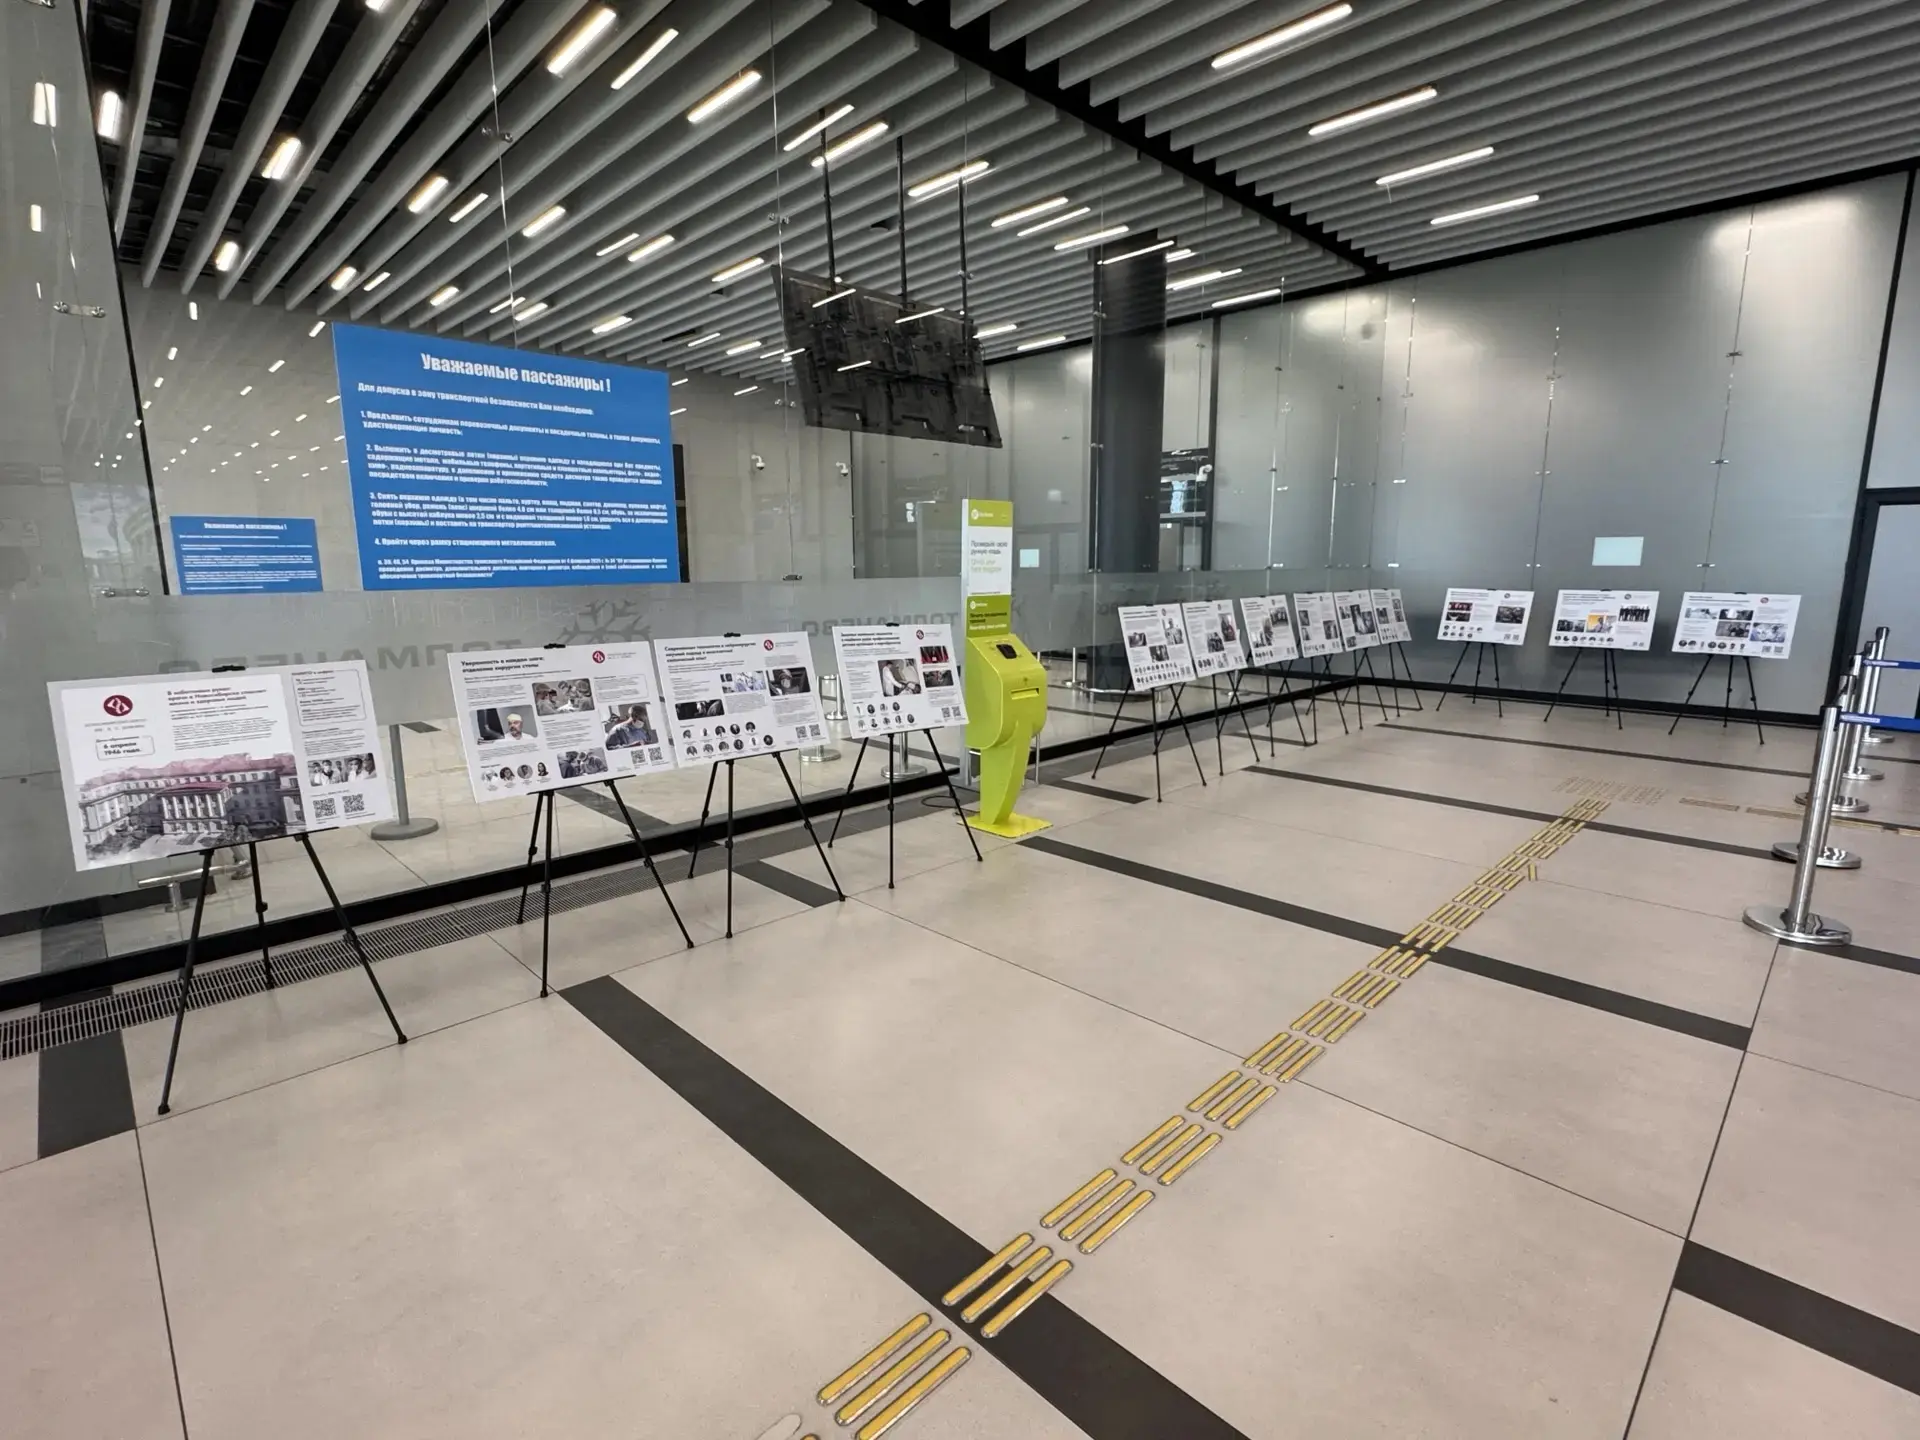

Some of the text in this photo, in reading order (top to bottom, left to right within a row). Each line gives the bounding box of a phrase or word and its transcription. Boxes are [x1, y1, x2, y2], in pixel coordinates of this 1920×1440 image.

[421, 353, 610, 392] Уважаемые пассажиры !
[357, 382, 374, 391] Для
[538, 402, 551, 410] Вам
